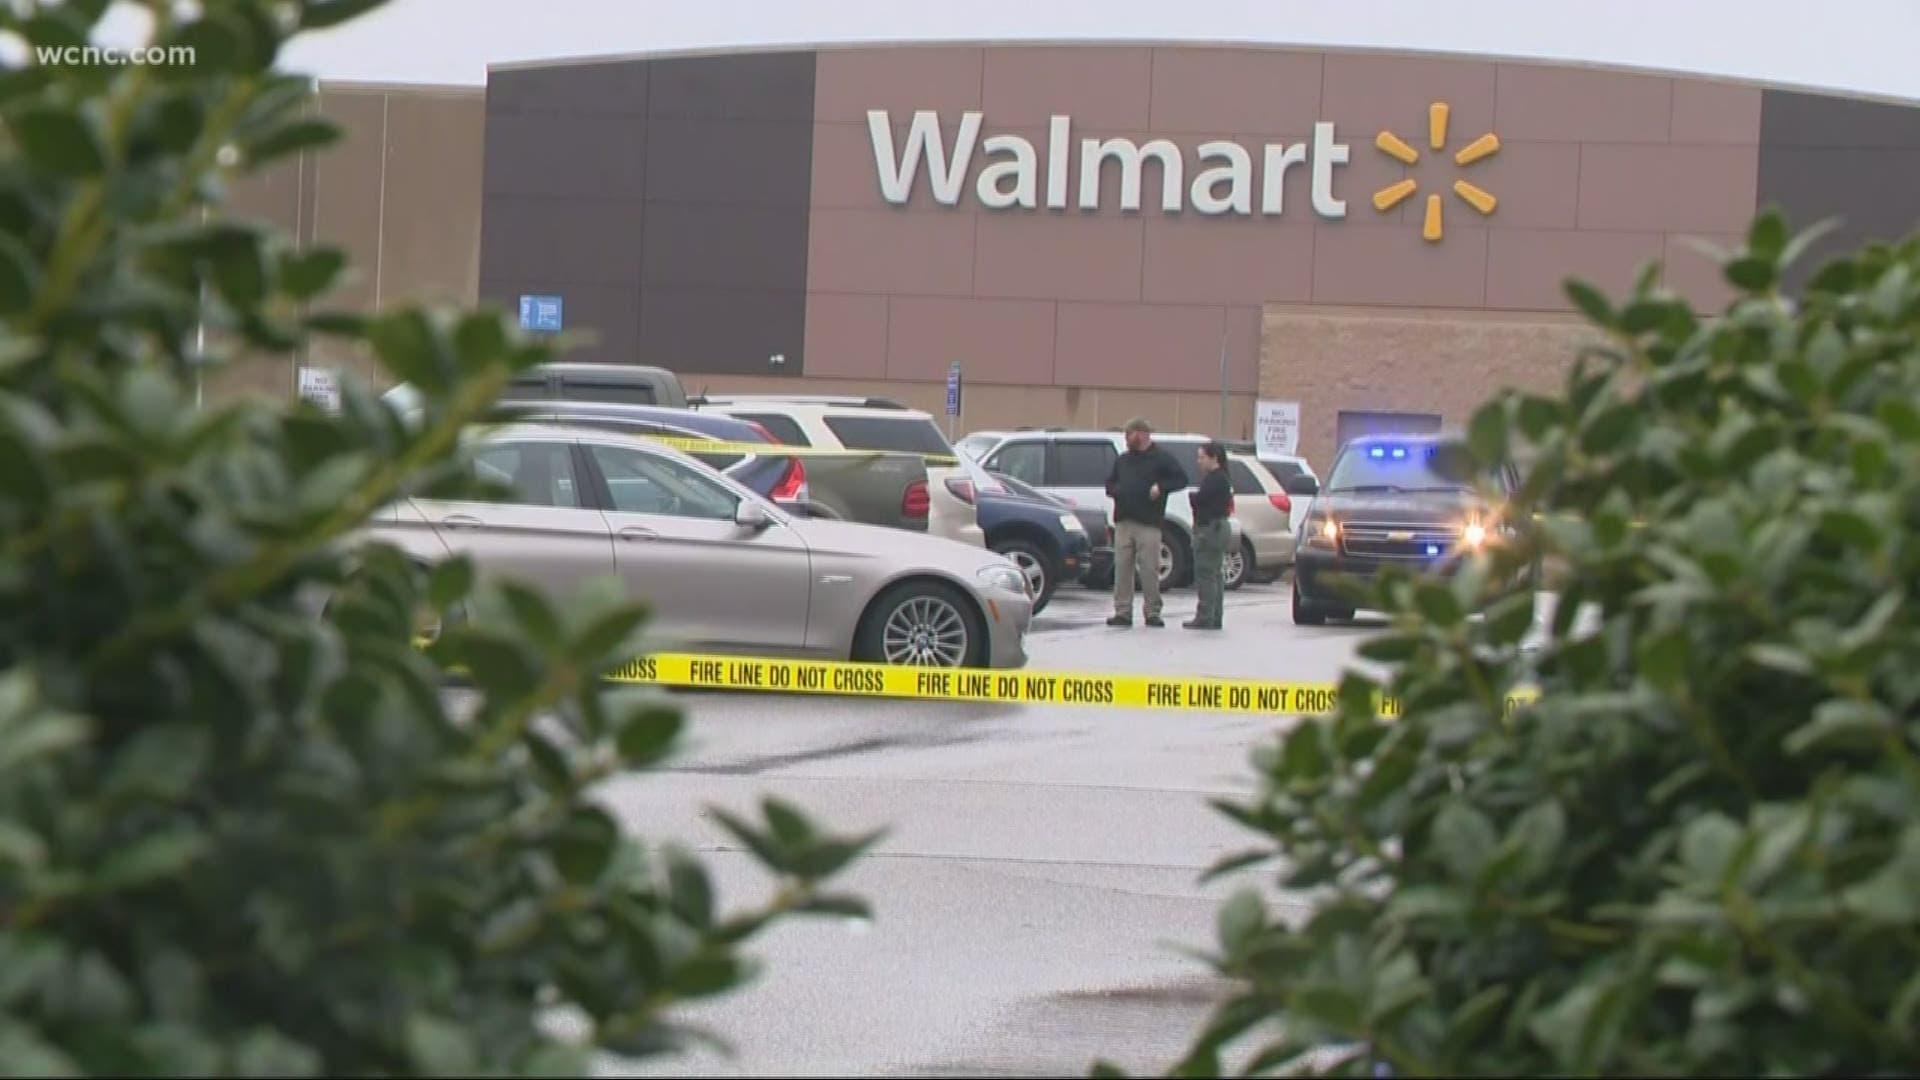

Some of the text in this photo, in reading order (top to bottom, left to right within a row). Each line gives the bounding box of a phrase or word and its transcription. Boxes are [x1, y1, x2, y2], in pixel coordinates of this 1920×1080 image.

[867, 110, 1350, 217] Walmart
[1258, 416, 1297, 426] PARKING
[1271, 409, 1285, 417] NO
[690, 660, 884, 691] FIRE LINE DO NOT CROSS
[917, 672, 1113, 702] FIRE LINE DO NOT CROSS
[1148, 684, 1336, 712] FIRE LINE DO NOT CROS
